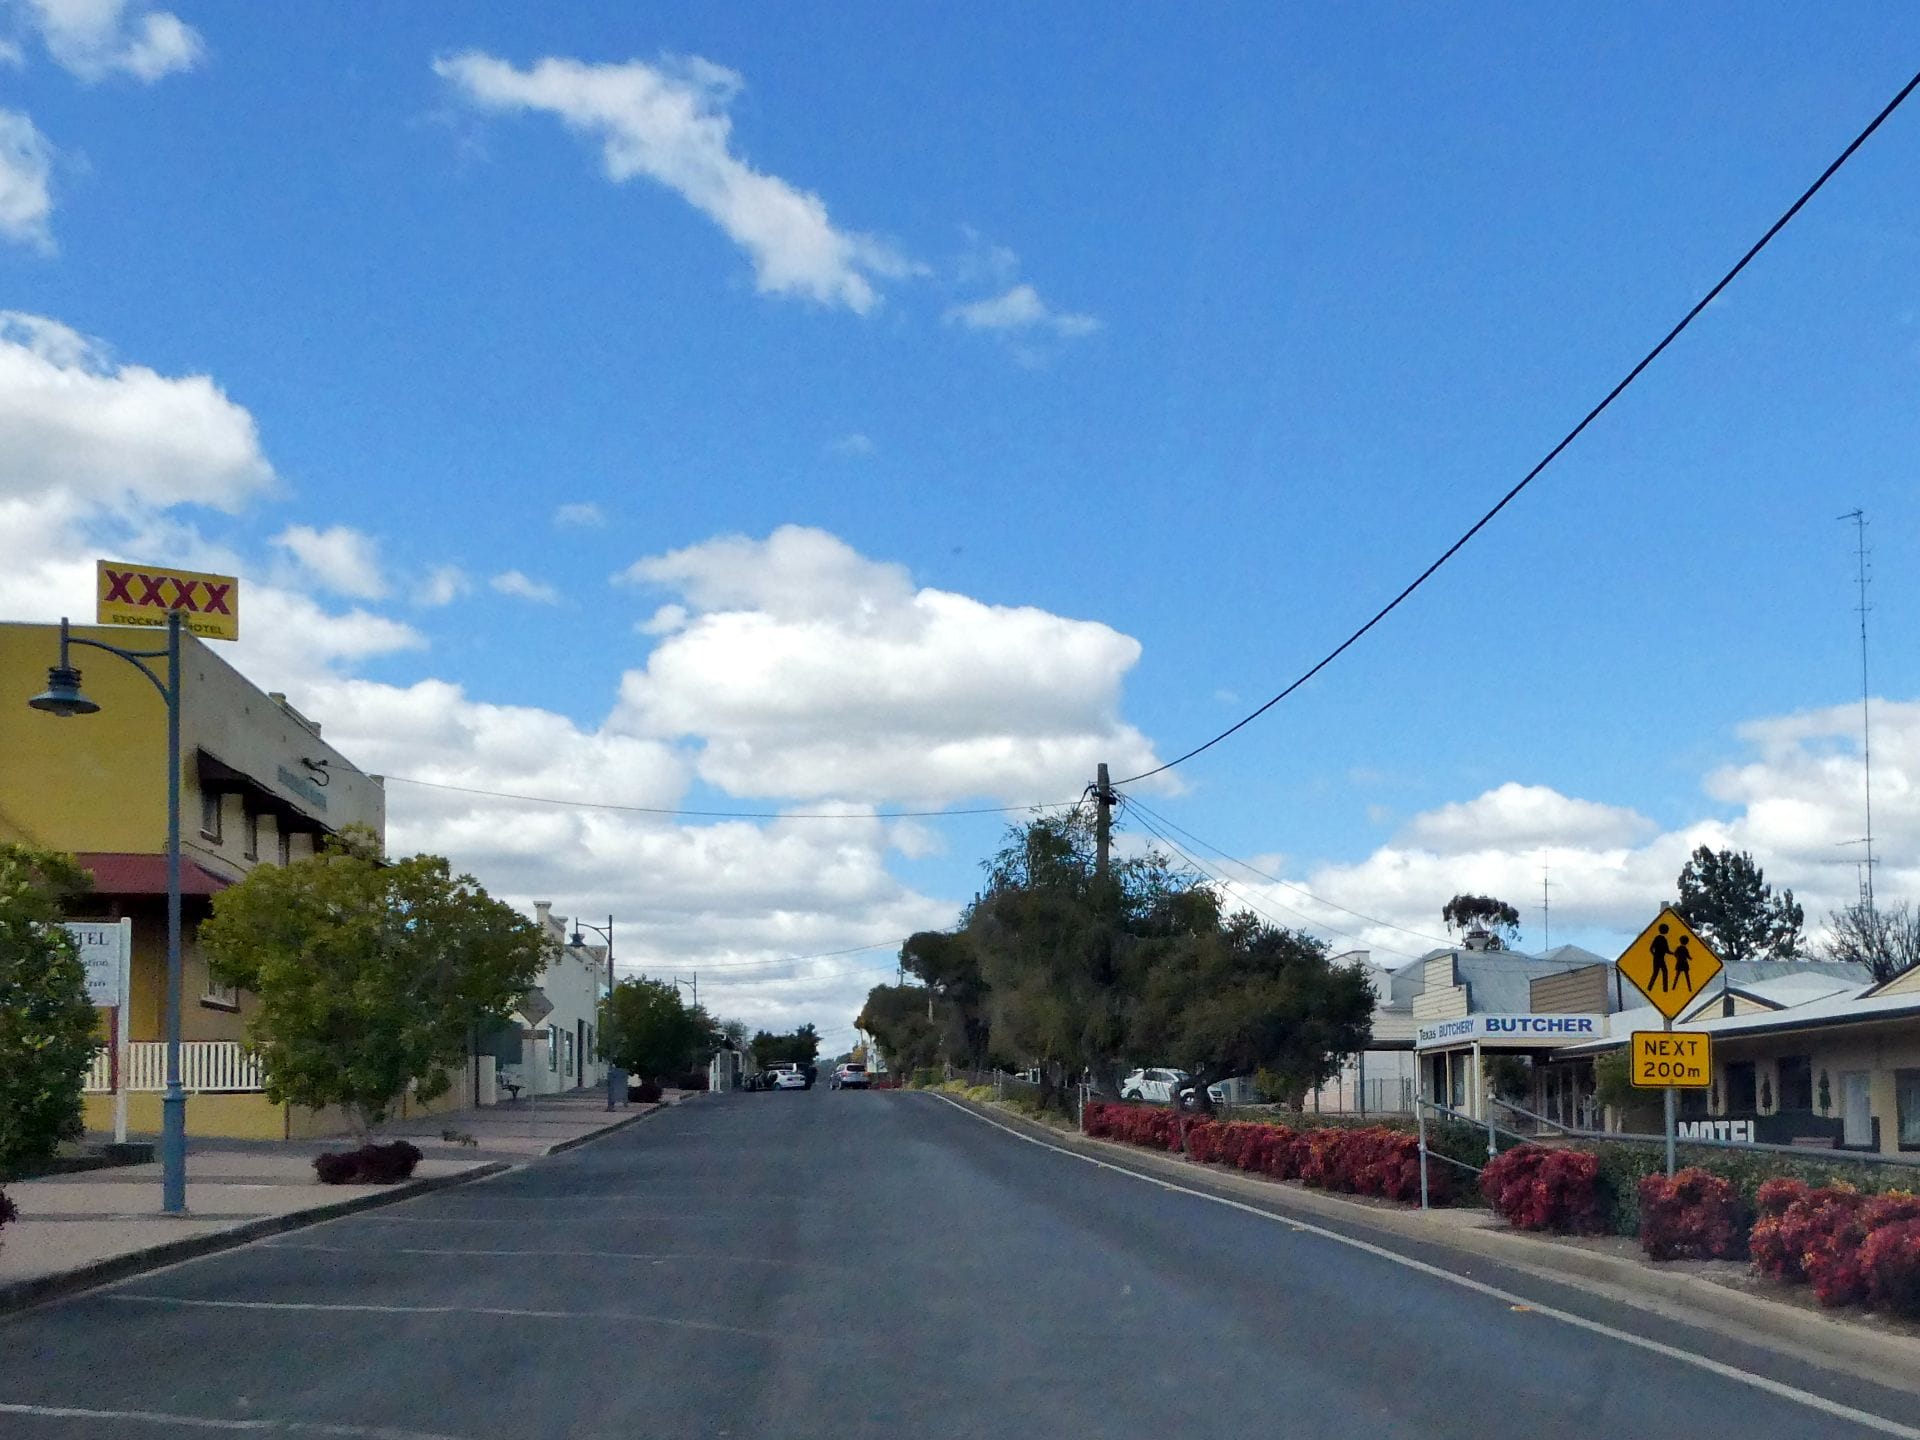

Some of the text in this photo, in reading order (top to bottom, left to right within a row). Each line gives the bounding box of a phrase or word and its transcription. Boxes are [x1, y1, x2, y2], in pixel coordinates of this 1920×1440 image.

[104, 569, 231, 615] XXXX
[112, 614, 173, 629] STOCKM
[74, 931, 110, 946] TEL
[1418, 1018, 1475, 1041] Texas BUTCHERY
[1485, 1018, 1593, 1032] BUTCHER
[1644, 1040, 1698, 1056] NEXT
[1643, 1062, 1700, 1078] 200m
[1678, 1119, 1755, 1144] MOTEL
